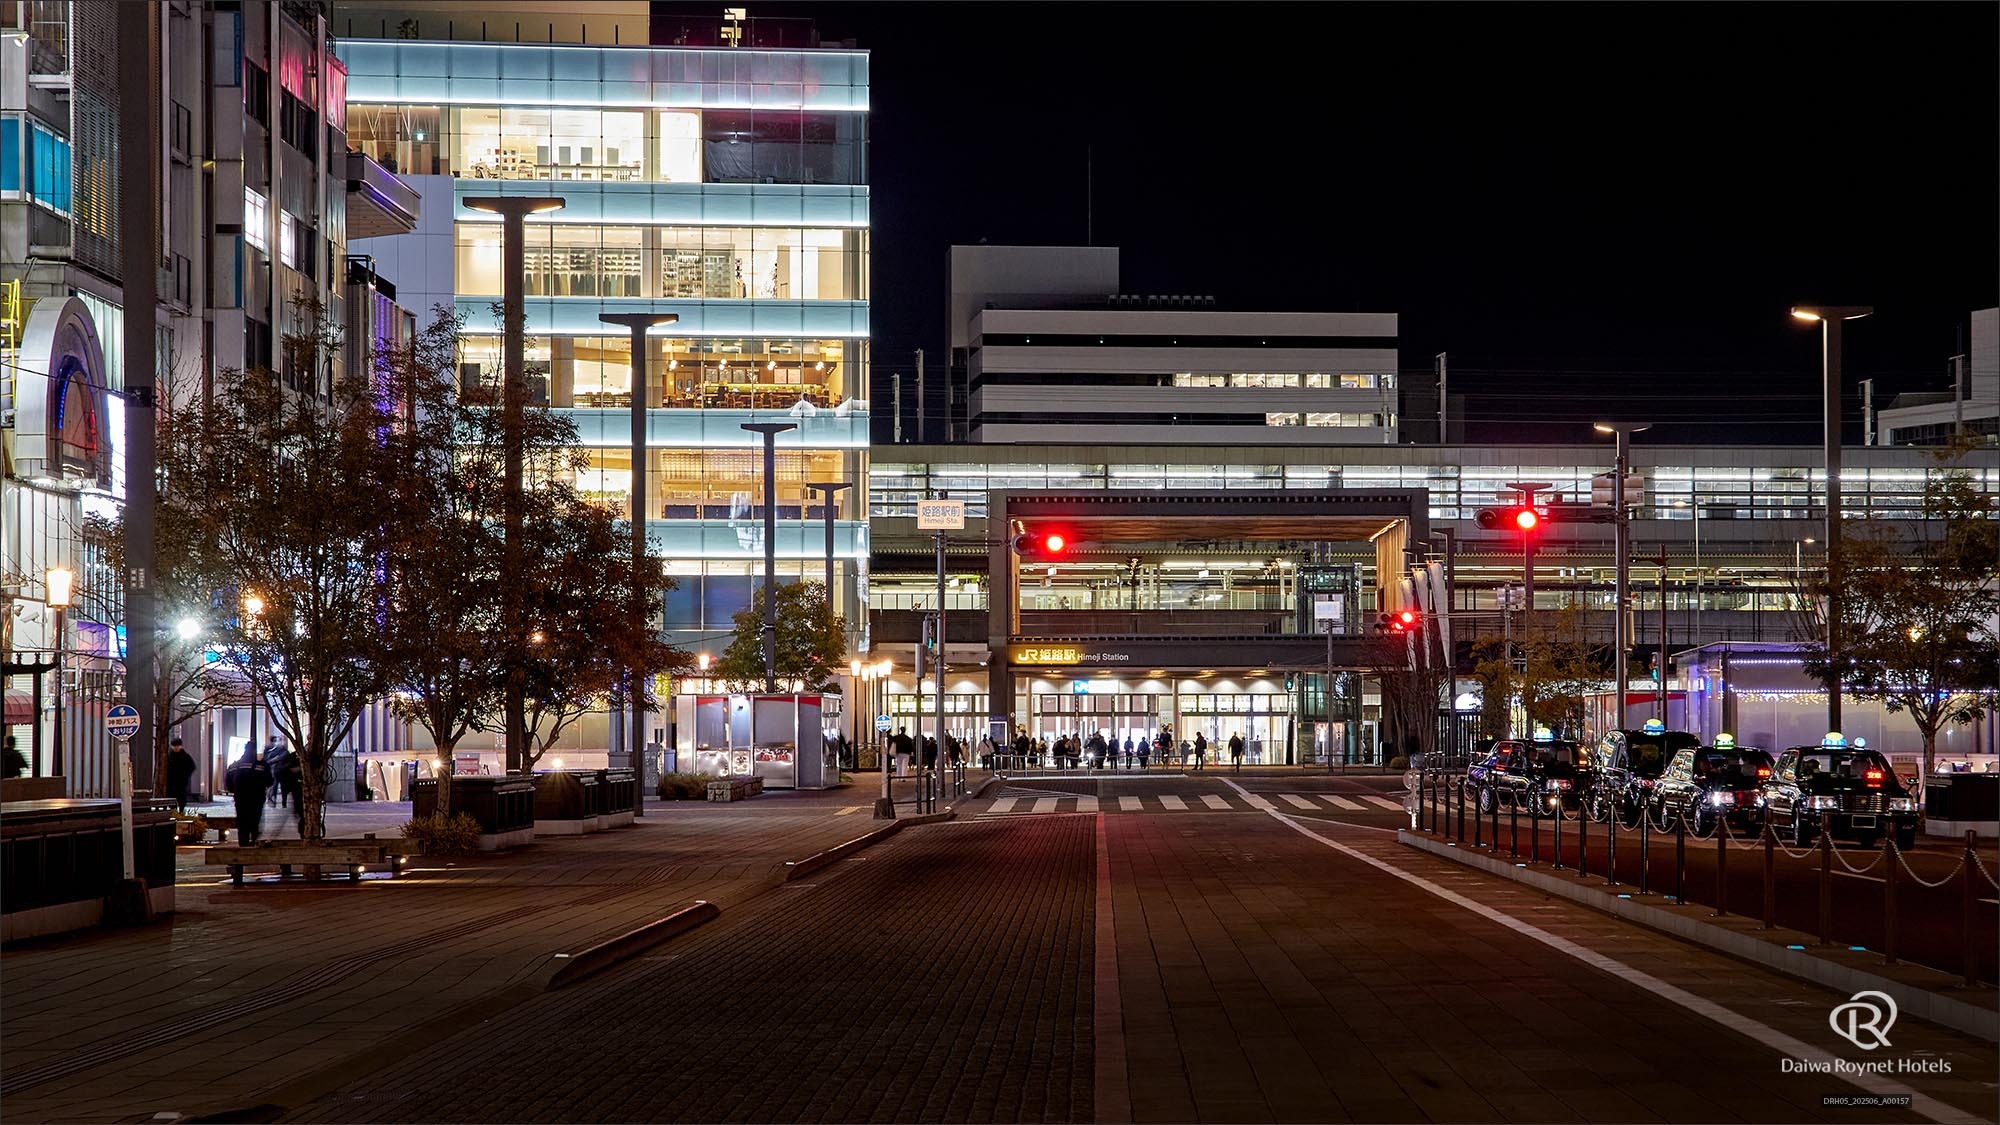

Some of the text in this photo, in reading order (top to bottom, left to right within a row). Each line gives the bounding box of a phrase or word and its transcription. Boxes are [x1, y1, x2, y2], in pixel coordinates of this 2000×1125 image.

[922, 505, 960, 517] 姫路駅前
[924, 517, 945, 525] Himeji
[1077, 652, 1129, 662] Himeji Station
[108, 717, 137, 726] 神姫バス
[113, 727, 133, 735] おりば
